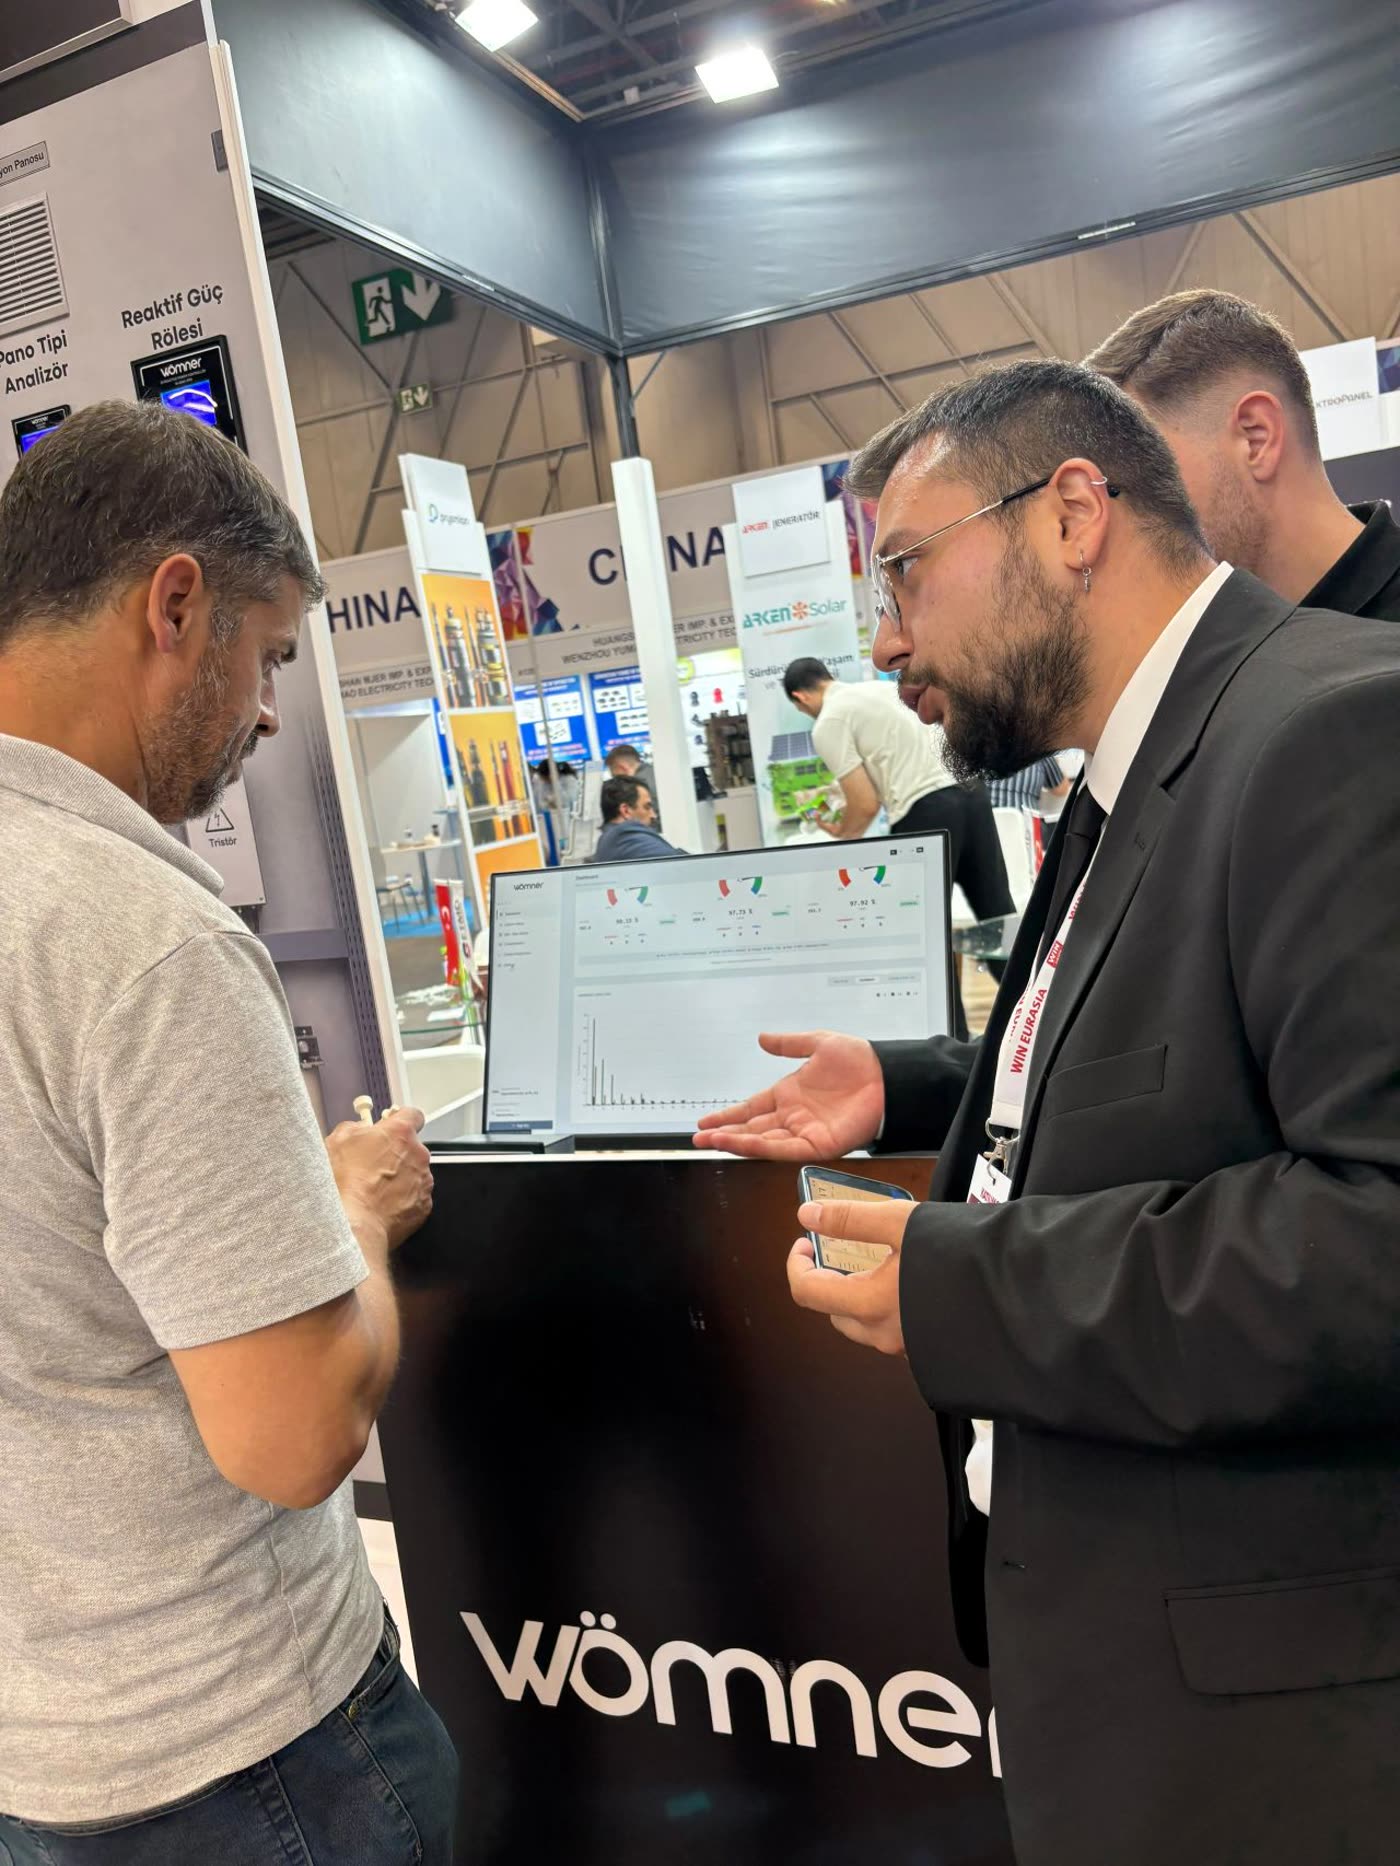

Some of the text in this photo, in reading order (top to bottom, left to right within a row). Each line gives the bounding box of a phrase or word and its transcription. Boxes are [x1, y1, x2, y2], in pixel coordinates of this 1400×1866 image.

[14, 152, 44, 170] Panosu
[121, 284, 223, 328] Reaktif Güç
[37, 329, 67, 354] Tipi
[151, 317, 203, 350] Rölesi
[6, 362, 68, 394] Analizör
[160, 358, 202, 377] wömner
[588, 526, 725, 586] CNA
[810, 600, 847, 616] Solar
[1049, 941, 1062, 963] WIN
[1010, 1044, 1028, 1075] WIN
[1020, 988, 1048, 1045] EURASIA
